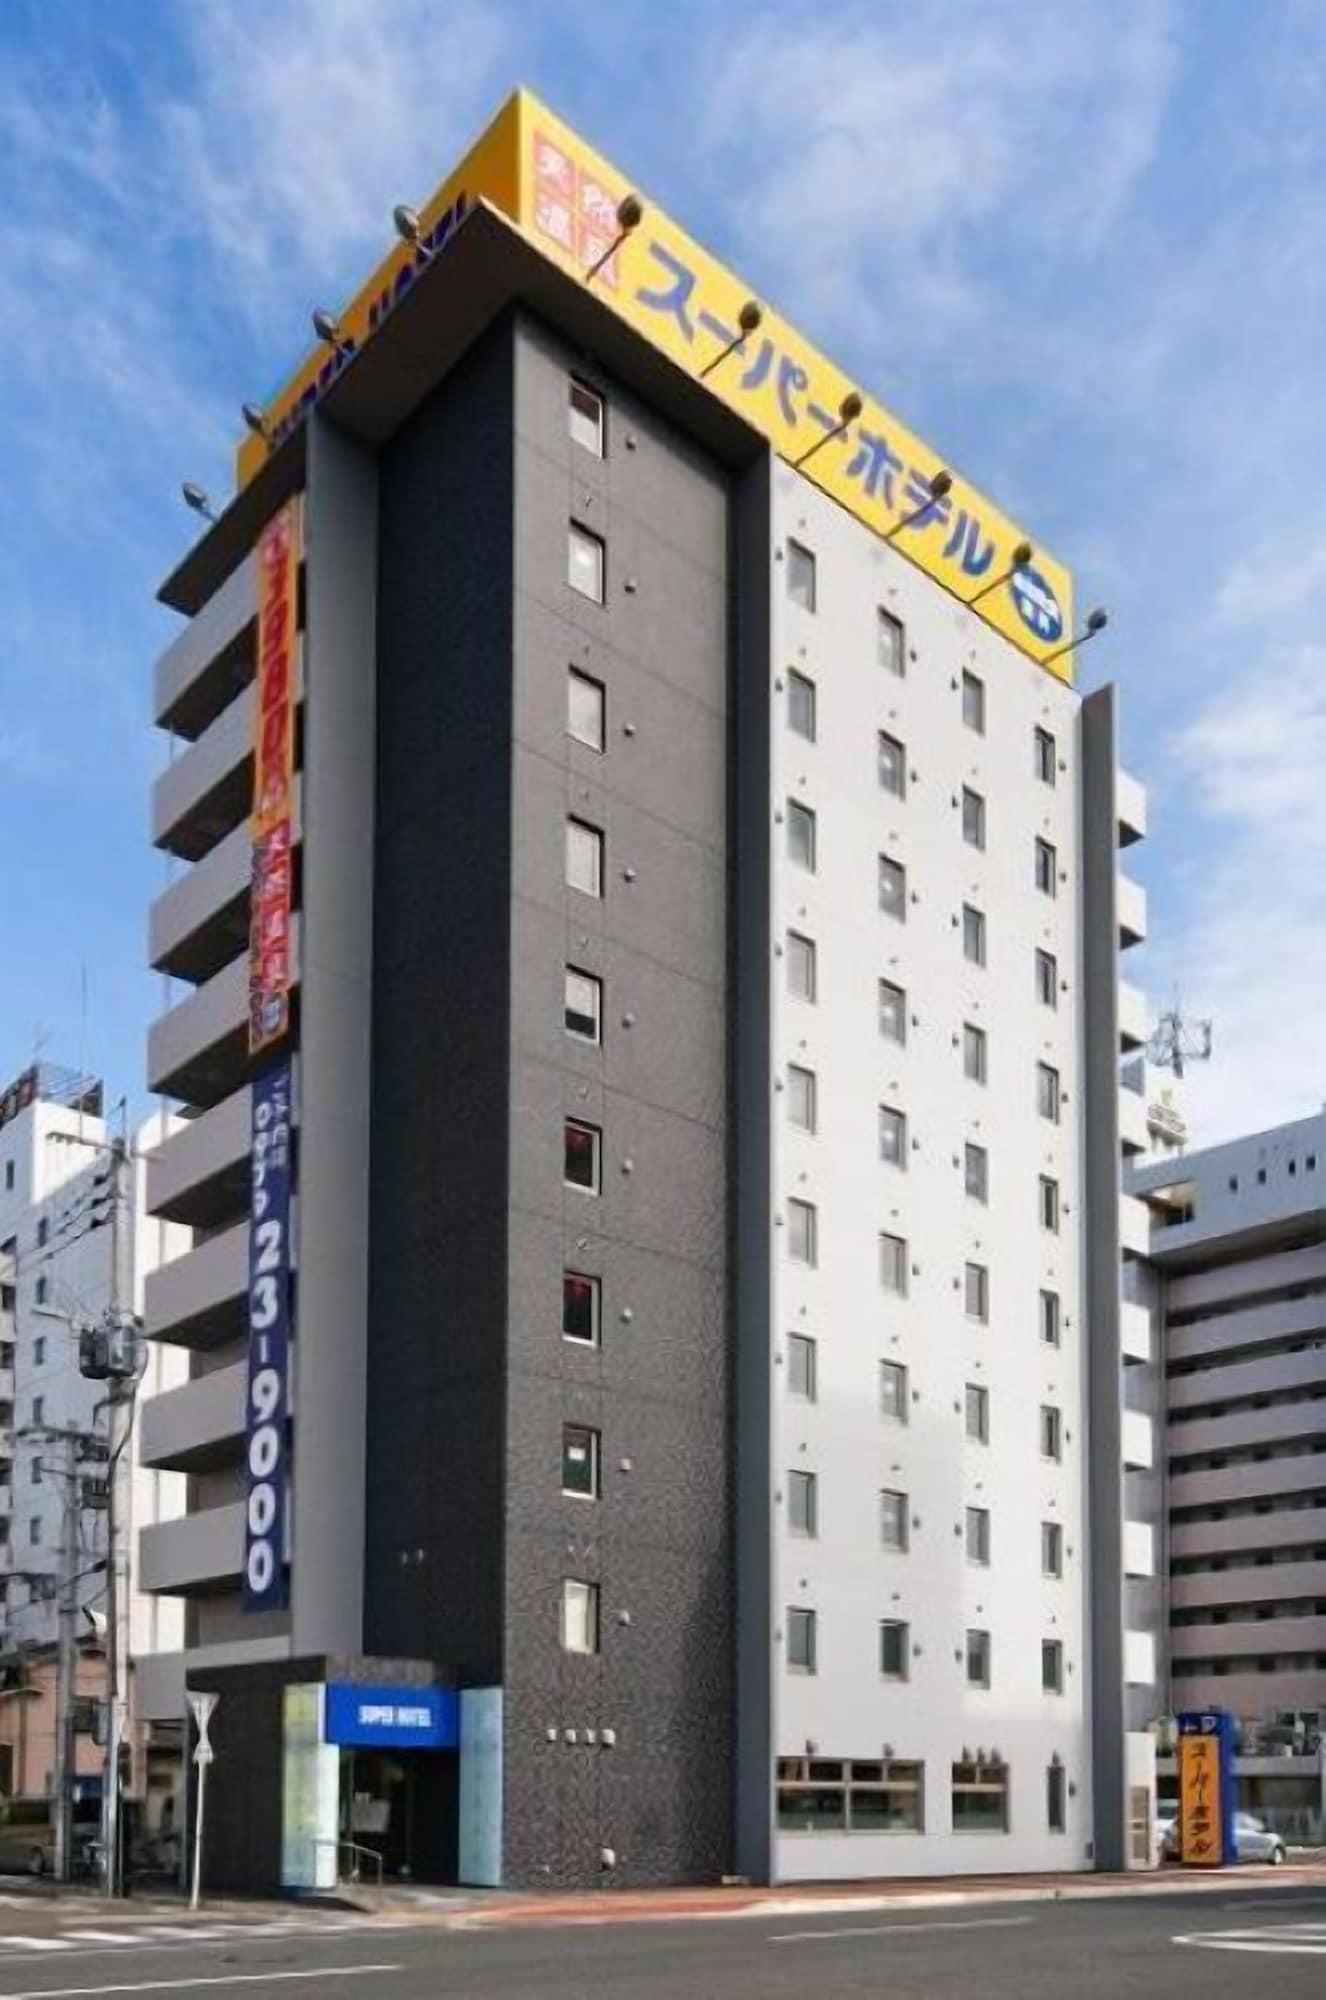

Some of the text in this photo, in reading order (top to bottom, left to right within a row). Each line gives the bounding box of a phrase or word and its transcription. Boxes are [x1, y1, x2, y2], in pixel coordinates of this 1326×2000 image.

[634, 240, 996, 577] スーパーホテル
[247, 1219, 282, 1593] 23-9000
